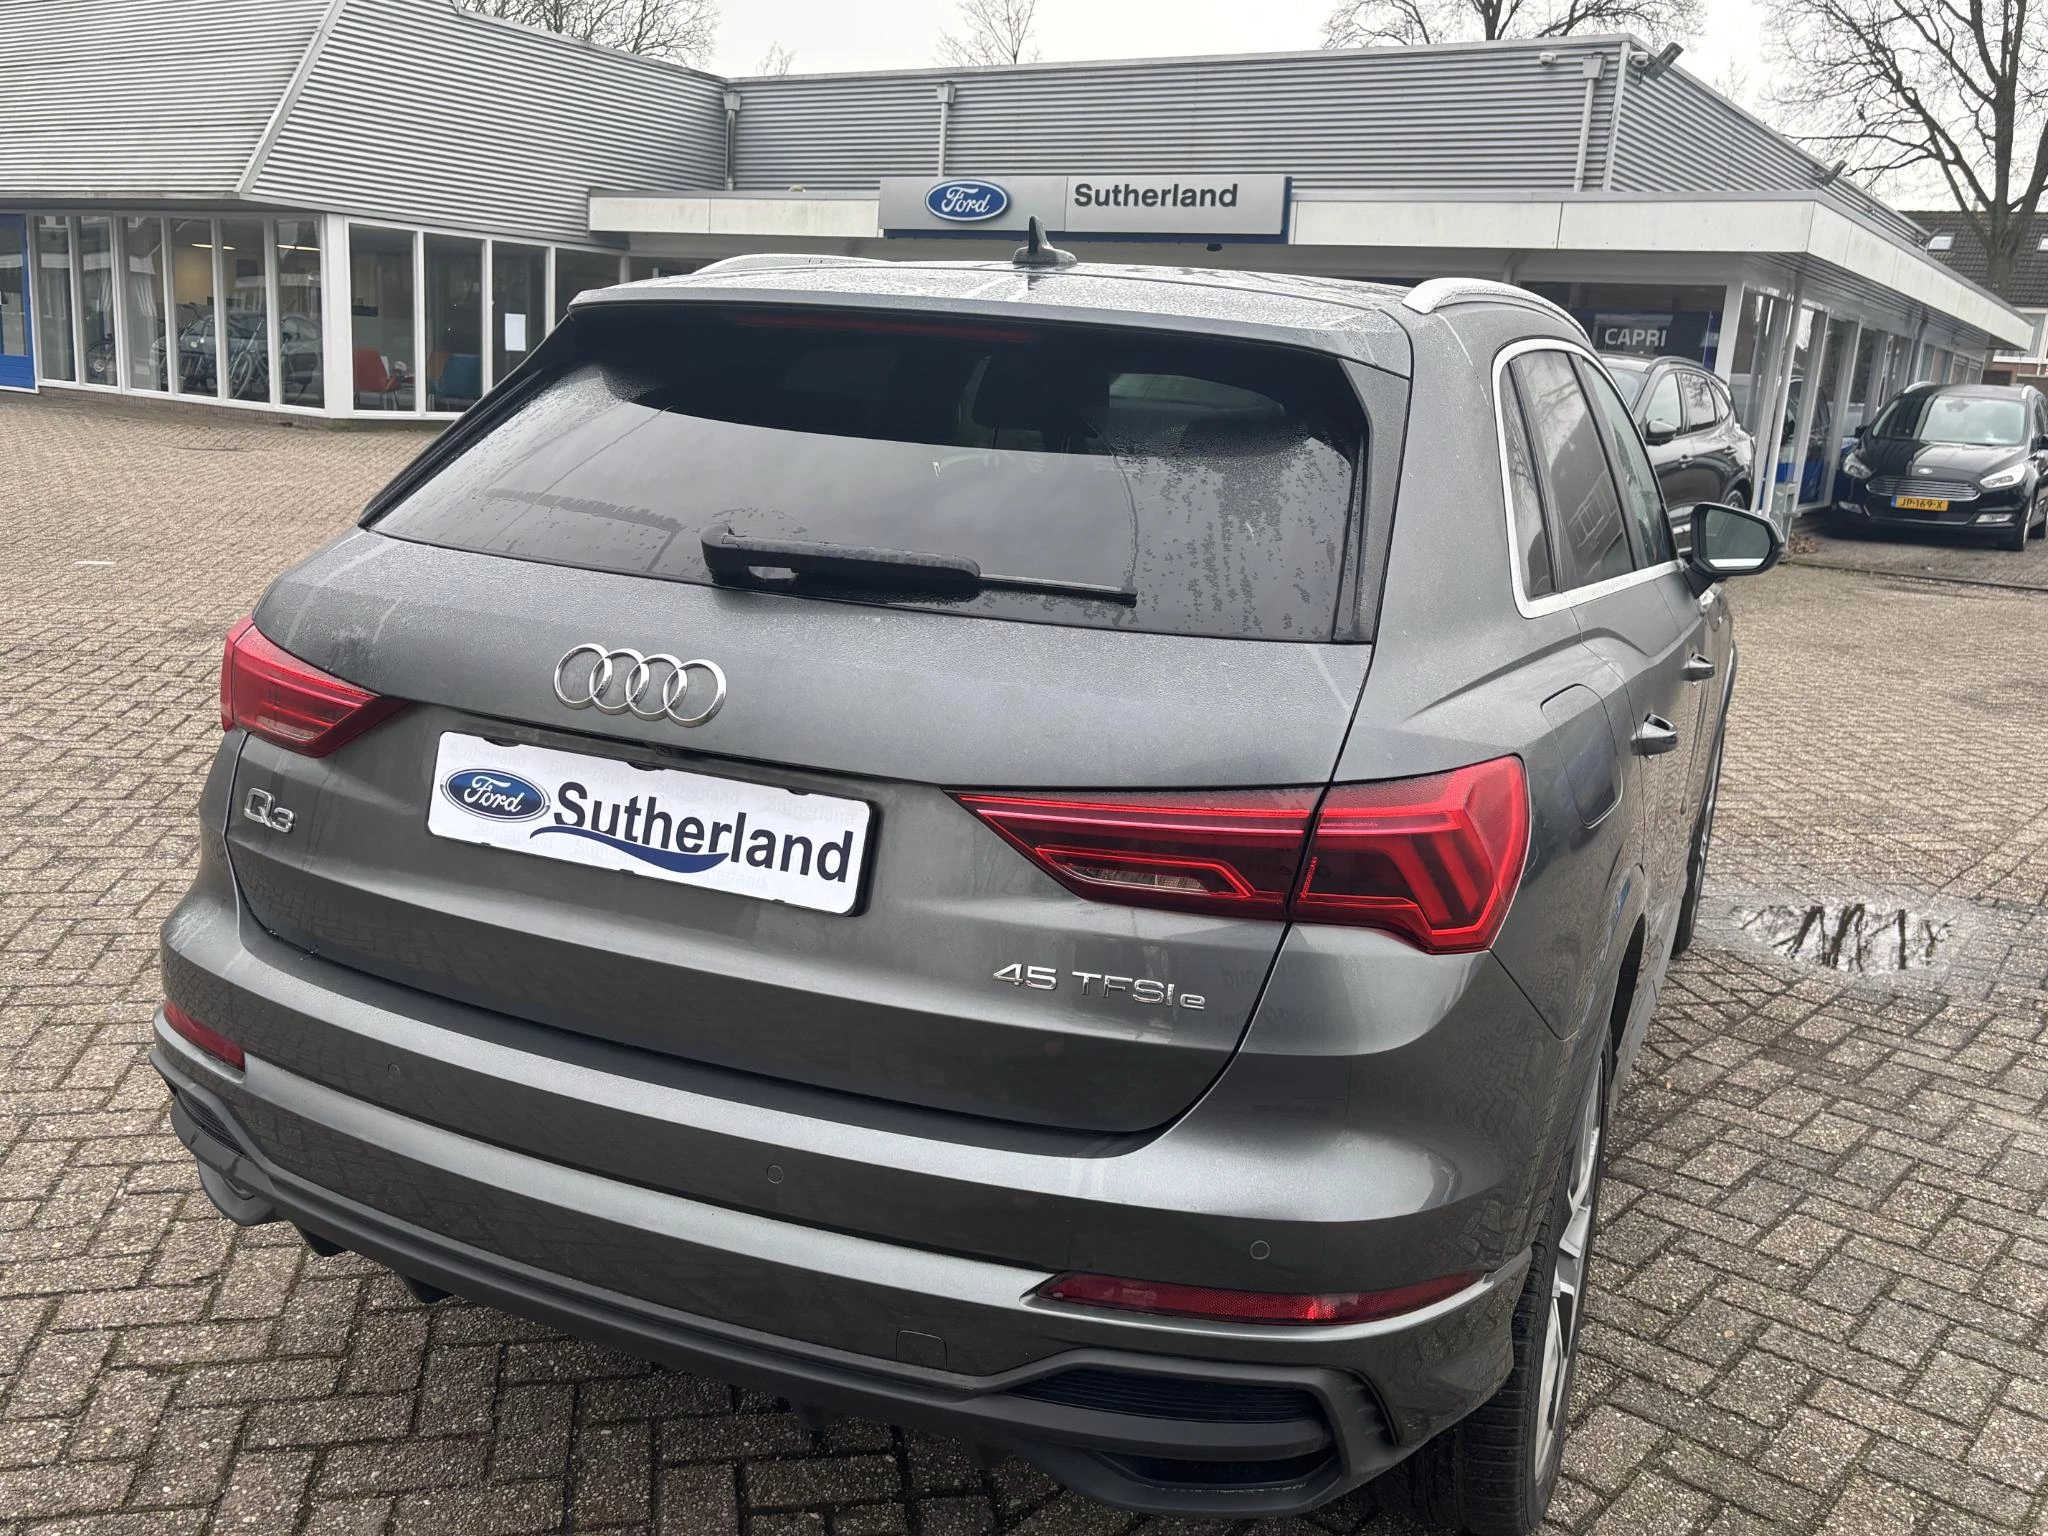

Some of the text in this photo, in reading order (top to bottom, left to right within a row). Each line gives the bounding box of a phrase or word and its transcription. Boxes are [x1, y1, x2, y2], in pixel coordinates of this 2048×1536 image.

[941, 187, 991, 214] Ford
[1074, 183, 1238, 207] Sutherland
[1604, 328, 1668, 347] CAPRI
[244, 788, 294, 833] Q3
[463, 775, 524, 813] Ford
[554, 782, 853, 883] Sutherland
[992, 963, 1057, 990] 45
